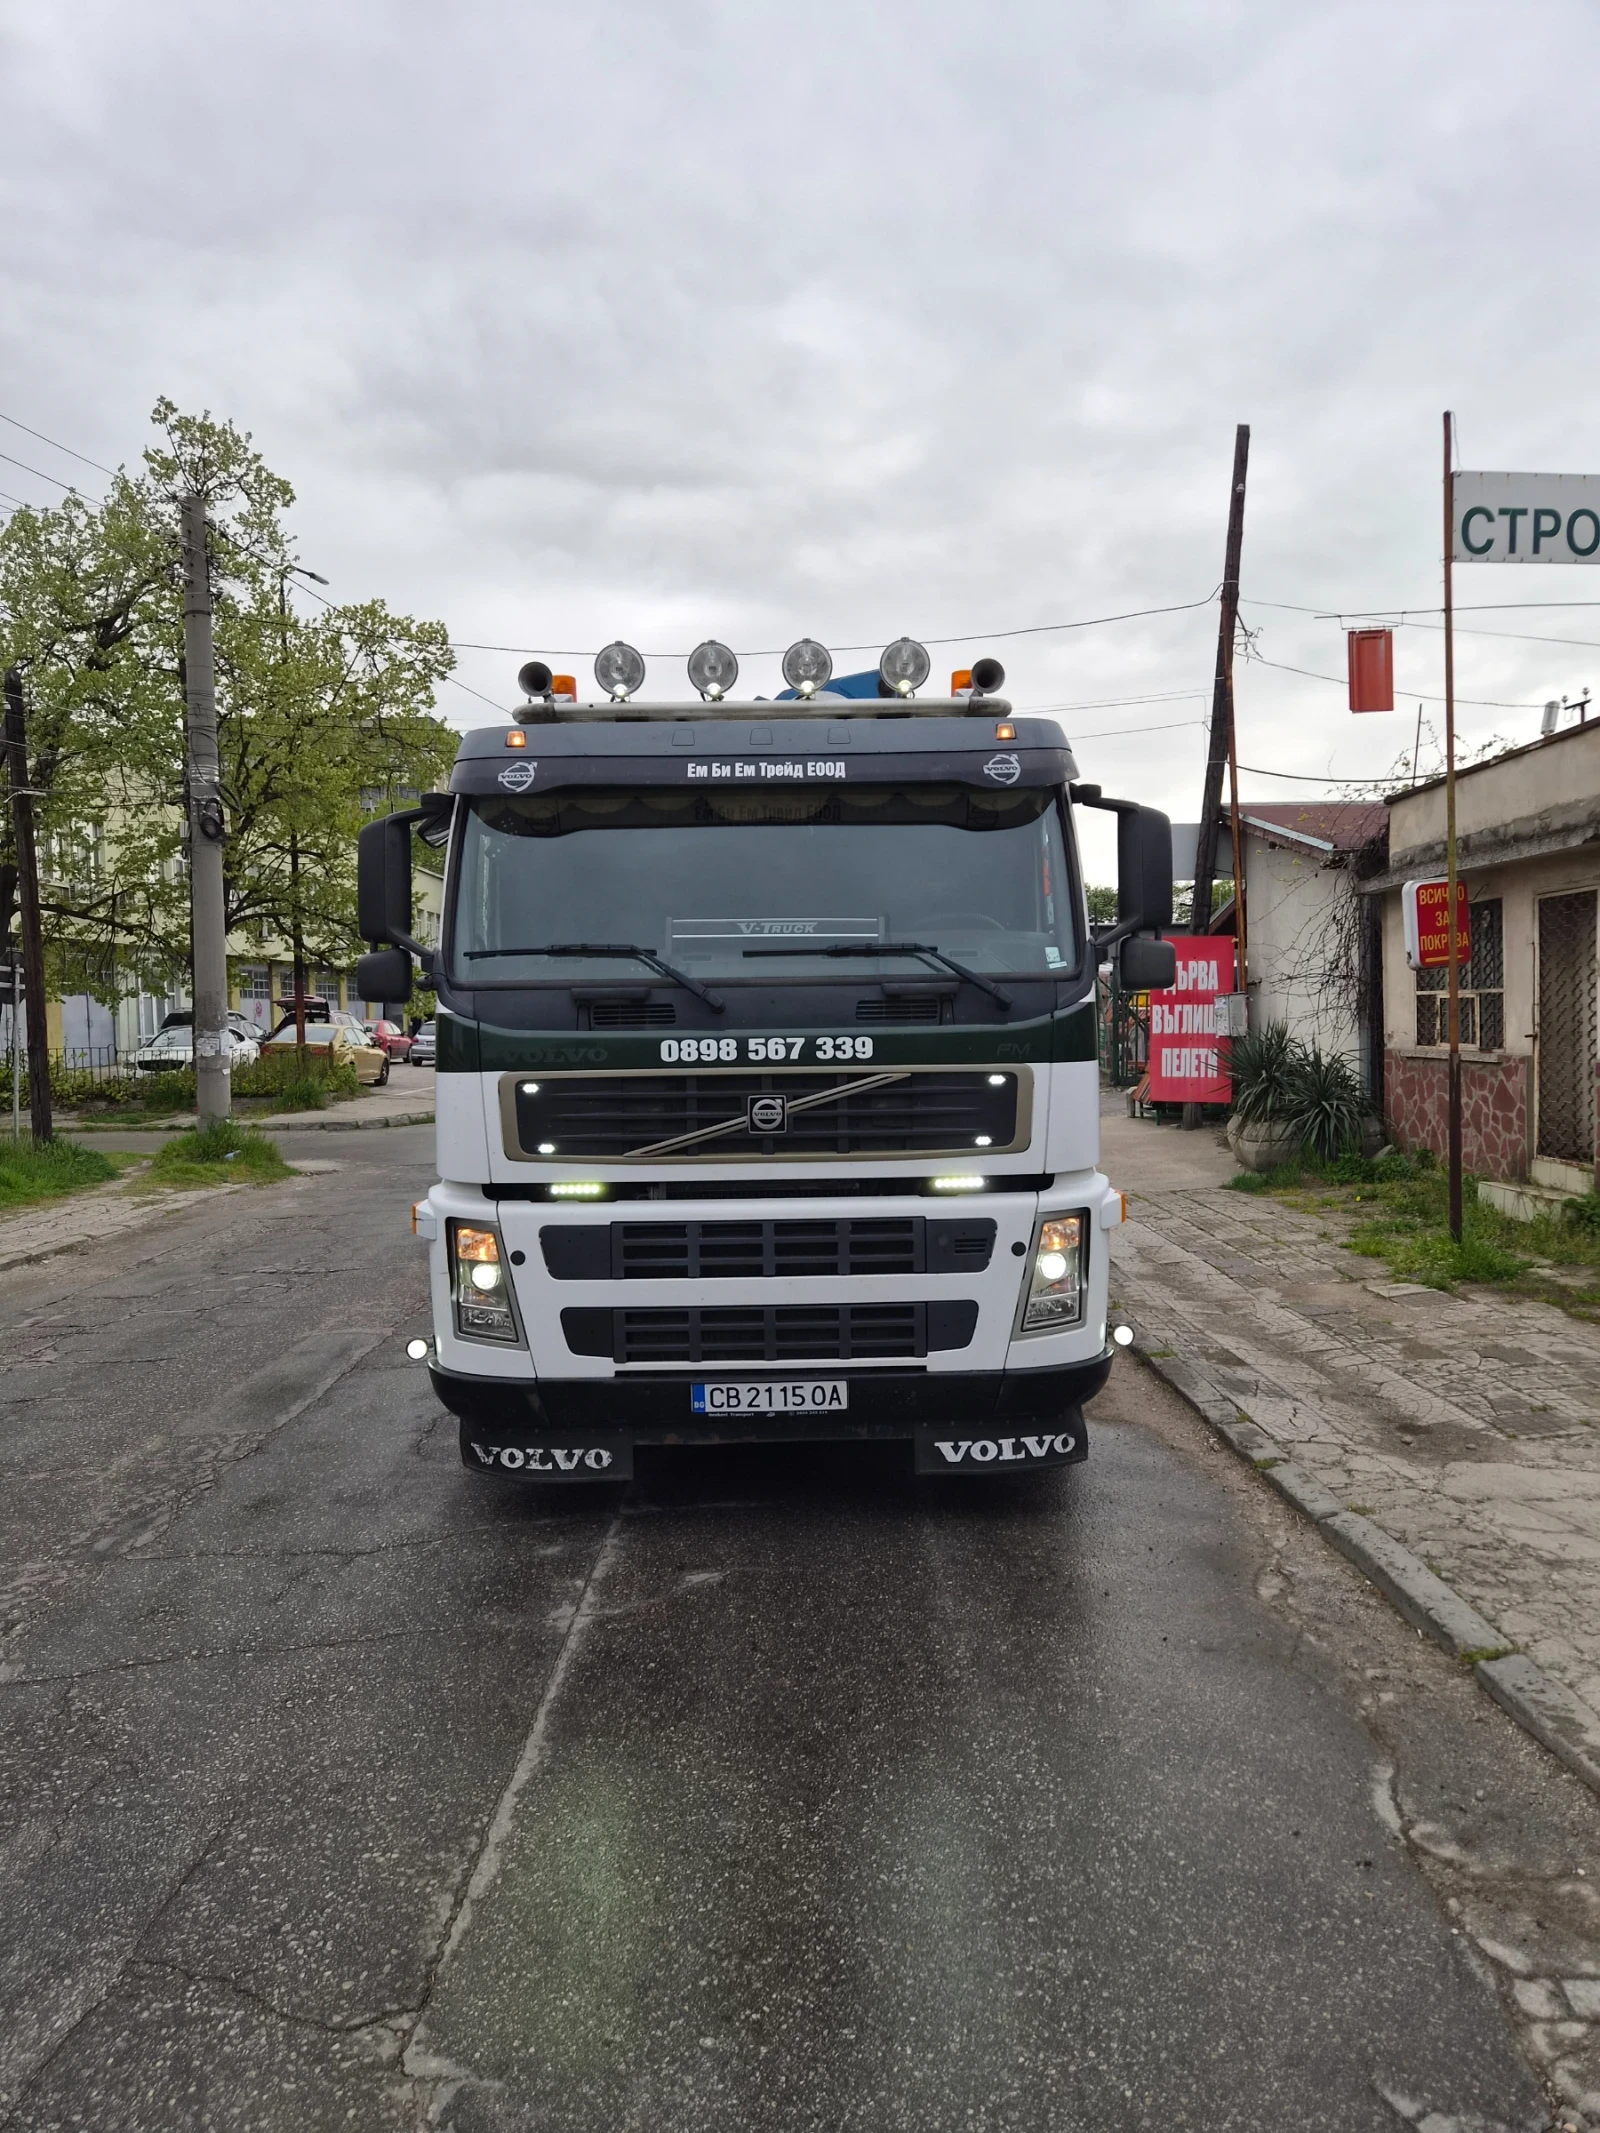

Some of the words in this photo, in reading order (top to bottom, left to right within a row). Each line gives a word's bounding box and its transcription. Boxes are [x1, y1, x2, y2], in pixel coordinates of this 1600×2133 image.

[1461, 506, 1600, 557] СТРО
[687, 763, 708, 778] Ем
[711, 762, 731, 777] Би
[734, 762, 756, 777] Ем
[759, 761, 804, 778] Трейд
[807, 761, 846, 778] ЕООД
[1420, 886, 1465, 905] ВСИЧО
[1435, 911, 1450, 927] ЗА
[1421, 932, 1469, 951] ПОКРВА
[1163, 961, 1219, 995] ЪРВА
[503, 1046, 609, 1063] VOLVO
[660, 1038, 738, 1062] 0898
[748, 1037, 805, 1060] 567
[815, 1036, 874, 1059] 339
[996, 1042, 1031, 1056] FM
[1161, 1048, 1218, 1078] ПЕЛЕТИ
[693, 1401, 705, 1409] BG
[746, 1385, 806, 1408] 2115
[470, 1442, 613, 1470] VOLVO
[934, 1433, 1076, 1463] VOLVO
